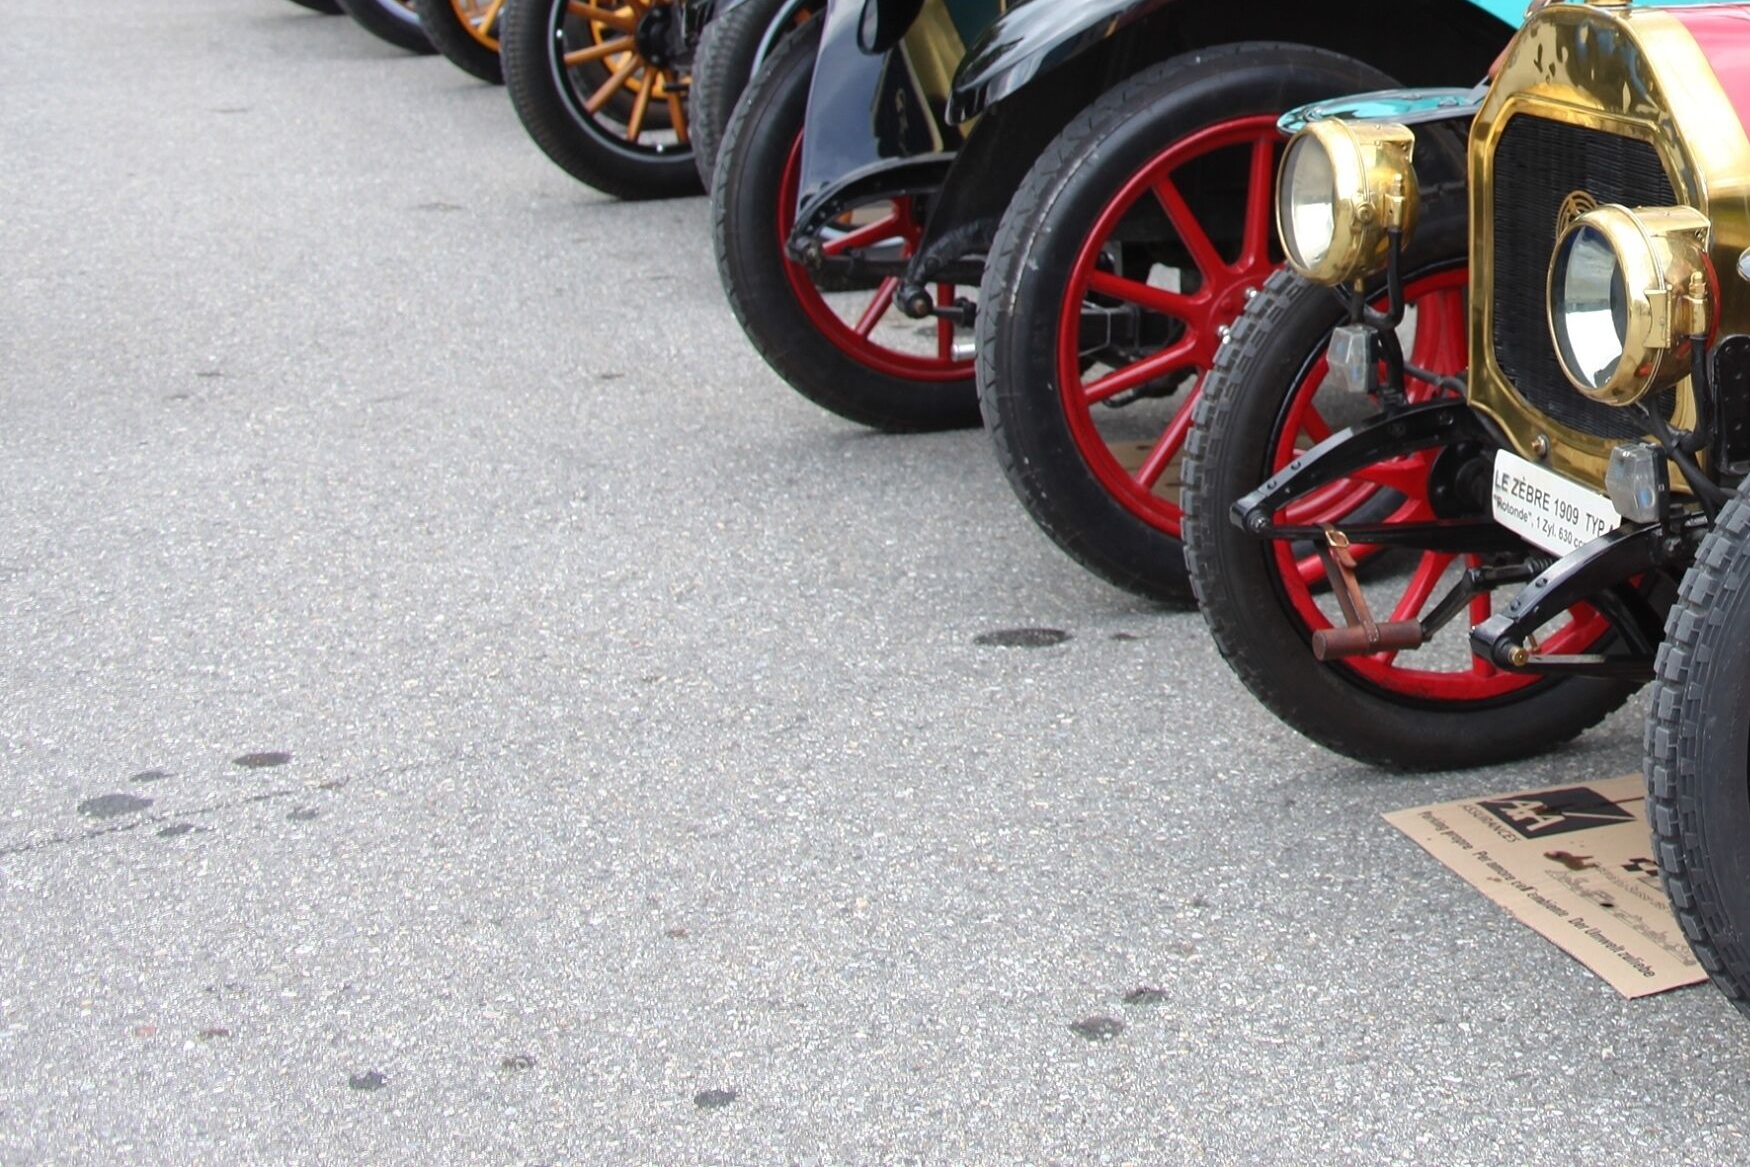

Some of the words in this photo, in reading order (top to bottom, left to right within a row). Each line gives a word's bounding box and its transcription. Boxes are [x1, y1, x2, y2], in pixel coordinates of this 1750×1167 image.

[1495, 470, 1510, 492] LE
[1554, 498, 1579, 526] 1909
[1542, 519, 1557, 537] Zyl.
[1559, 527, 1573, 545] 630
[1458, 803, 1522, 843] ASSURANCES
[1499, 800, 1567, 831] AXA
[1472, 850, 1493, 862] Per
[1567, 916, 1590, 930] Der
[1584, 927, 1626, 953] Umwelt
[1617, 951, 1656, 978] zuliebe
